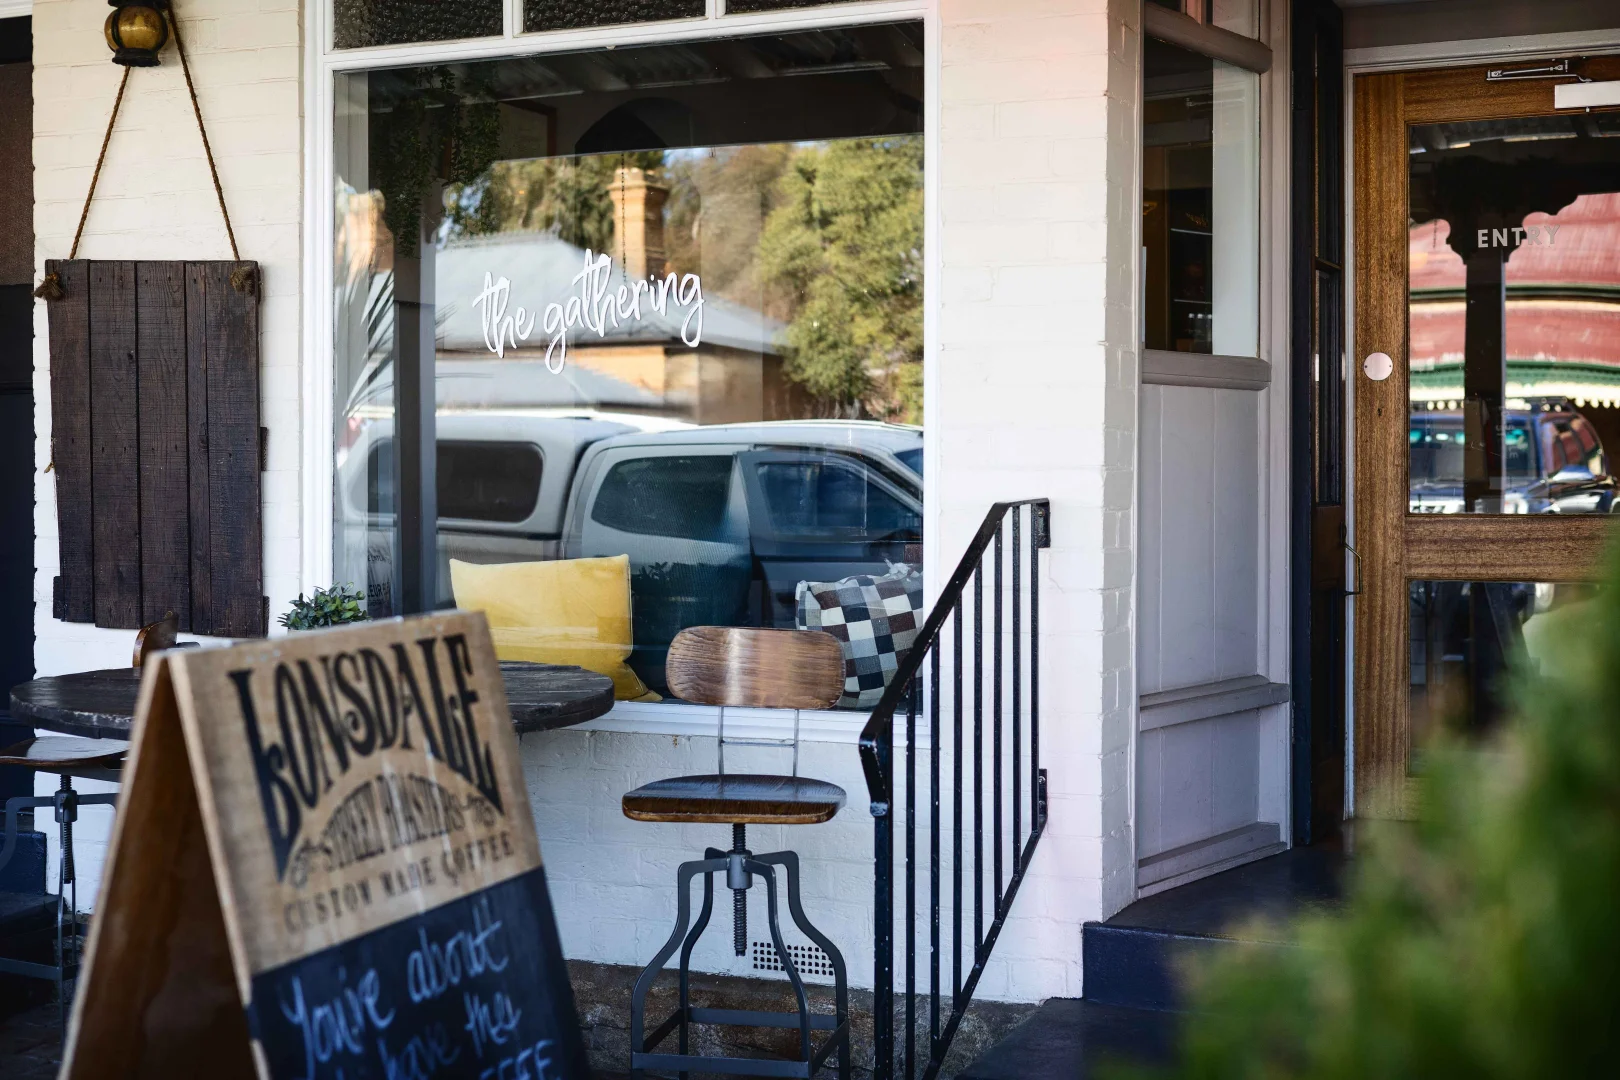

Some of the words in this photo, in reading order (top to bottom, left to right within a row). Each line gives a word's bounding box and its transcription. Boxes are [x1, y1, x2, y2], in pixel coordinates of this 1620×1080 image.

[1477, 224, 1561, 249] ENTRY
[472, 271, 536, 359] the
[543, 248, 705, 375] gathering
[227, 633, 505, 884] LONSDALE
[283, 877, 374, 934] CUSTOM
[380, 855, 436, 898] MADE
[440, 830, 516, 888] COFFEE
